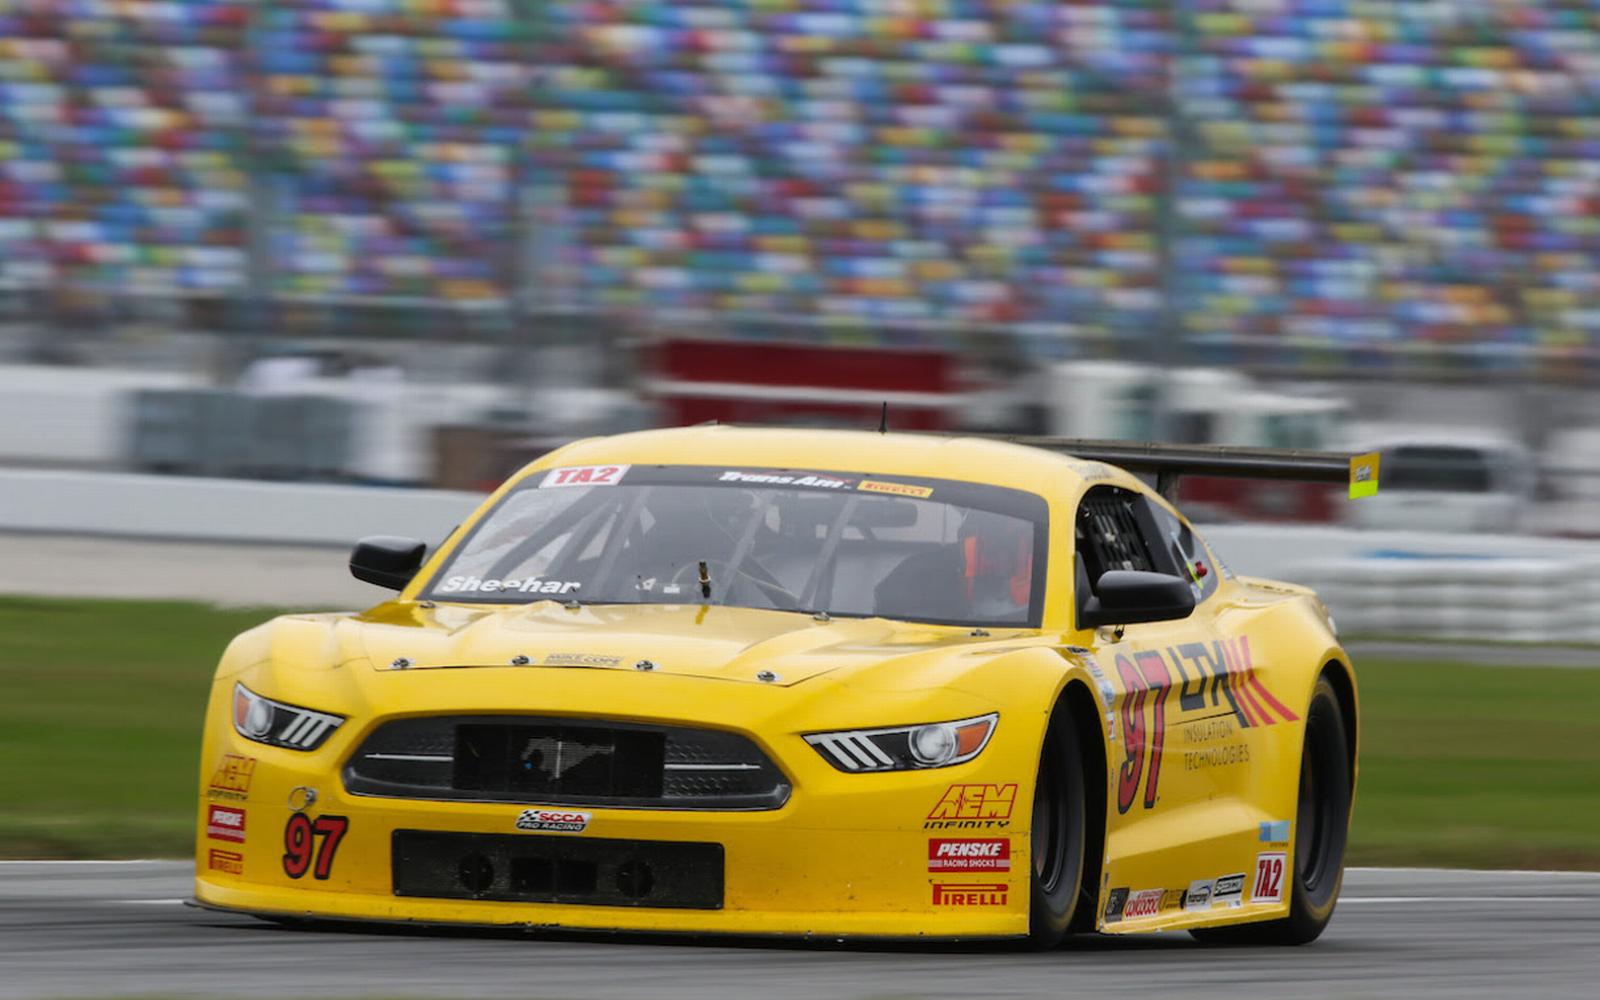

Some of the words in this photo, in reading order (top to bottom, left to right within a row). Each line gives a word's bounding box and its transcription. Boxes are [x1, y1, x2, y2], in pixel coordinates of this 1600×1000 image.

[555, 467, 619, 484] TA2
[718, 471, 795, 484] Trans
[794, 476, 845, 488] Am
[1115, 649, 1171, 814] 97
[1183, 720, 1233, 744] INSULATION
[1183, 744, 1250, 772] TECHNOLOGIES
[926, 784, 1018, 819] AEM
[518, 821, 541, 829] PRO
[541, 822, 583, 831] RACING
[539, 812, 585, 823] SCCA
[282, 812, 349, 880] 97
[937, 842, 1003, 857] PENSKE
[943, 859, 969, 868] RACING
[968, 859, 996, 868] SHOCKS
[1254, 858, 1283, 898] TA2
[931, 883, 1009, 906] PIRELLI
